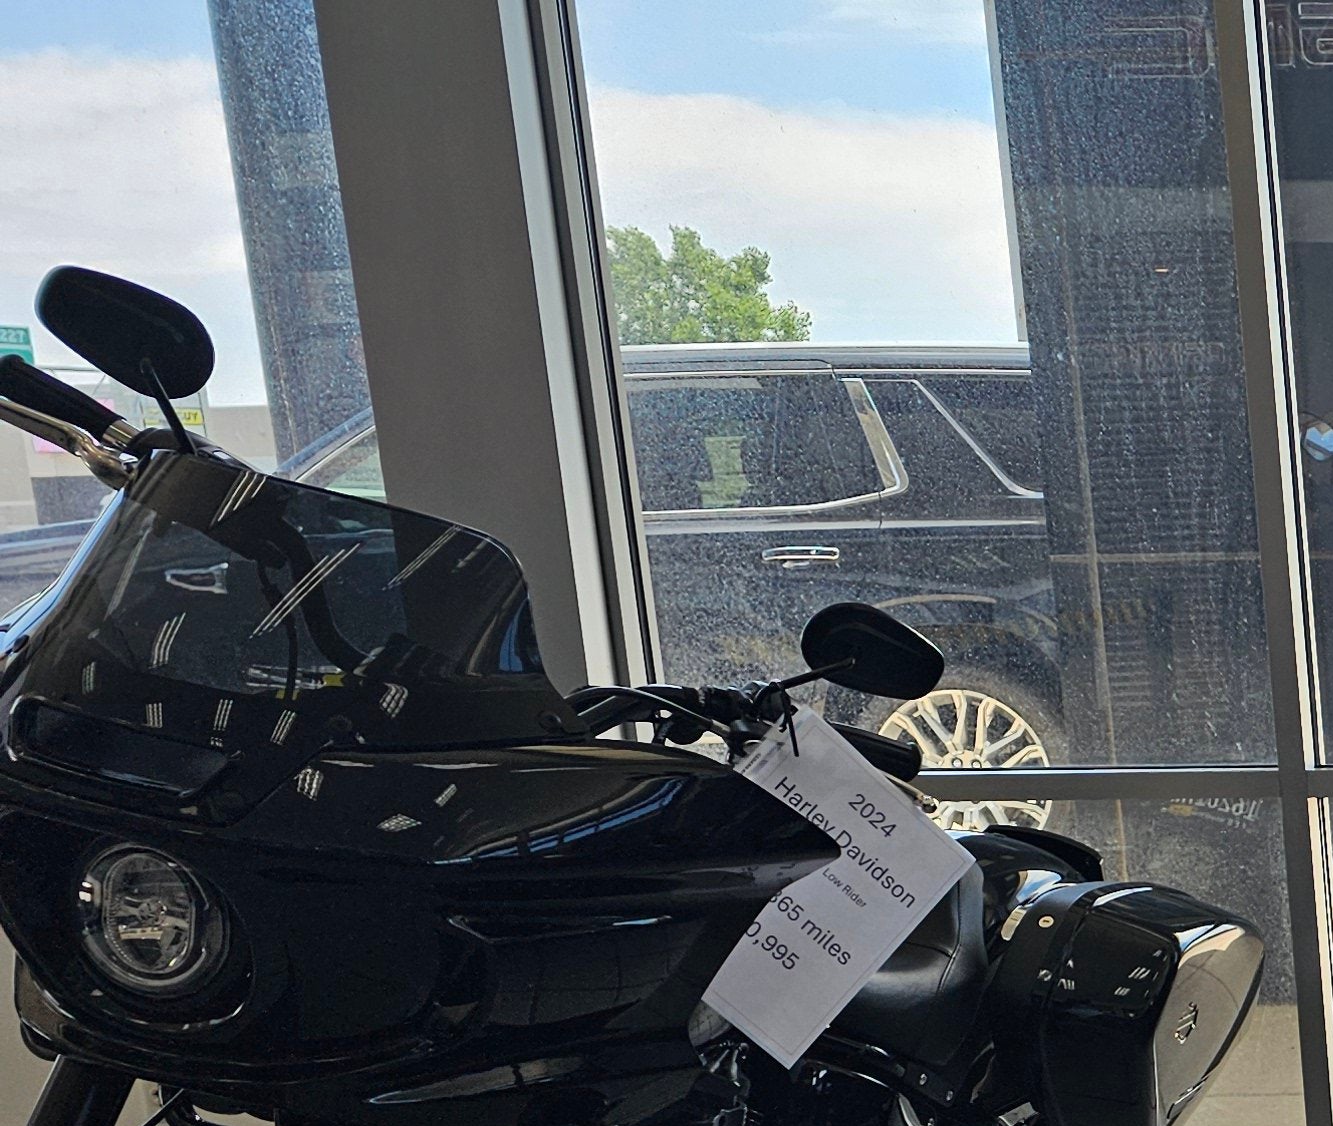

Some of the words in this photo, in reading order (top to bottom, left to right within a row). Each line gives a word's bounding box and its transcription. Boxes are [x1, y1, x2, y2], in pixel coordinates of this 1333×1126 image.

[848, 793, 897, 838] 2024
[774, 776, 836, 832] Harley
[835, 830, 916, 908] Davidson
[822, 868, 844, 888] Low
[842, 885, 867, 908] Rider
[801, 919, 851, 966] miles
